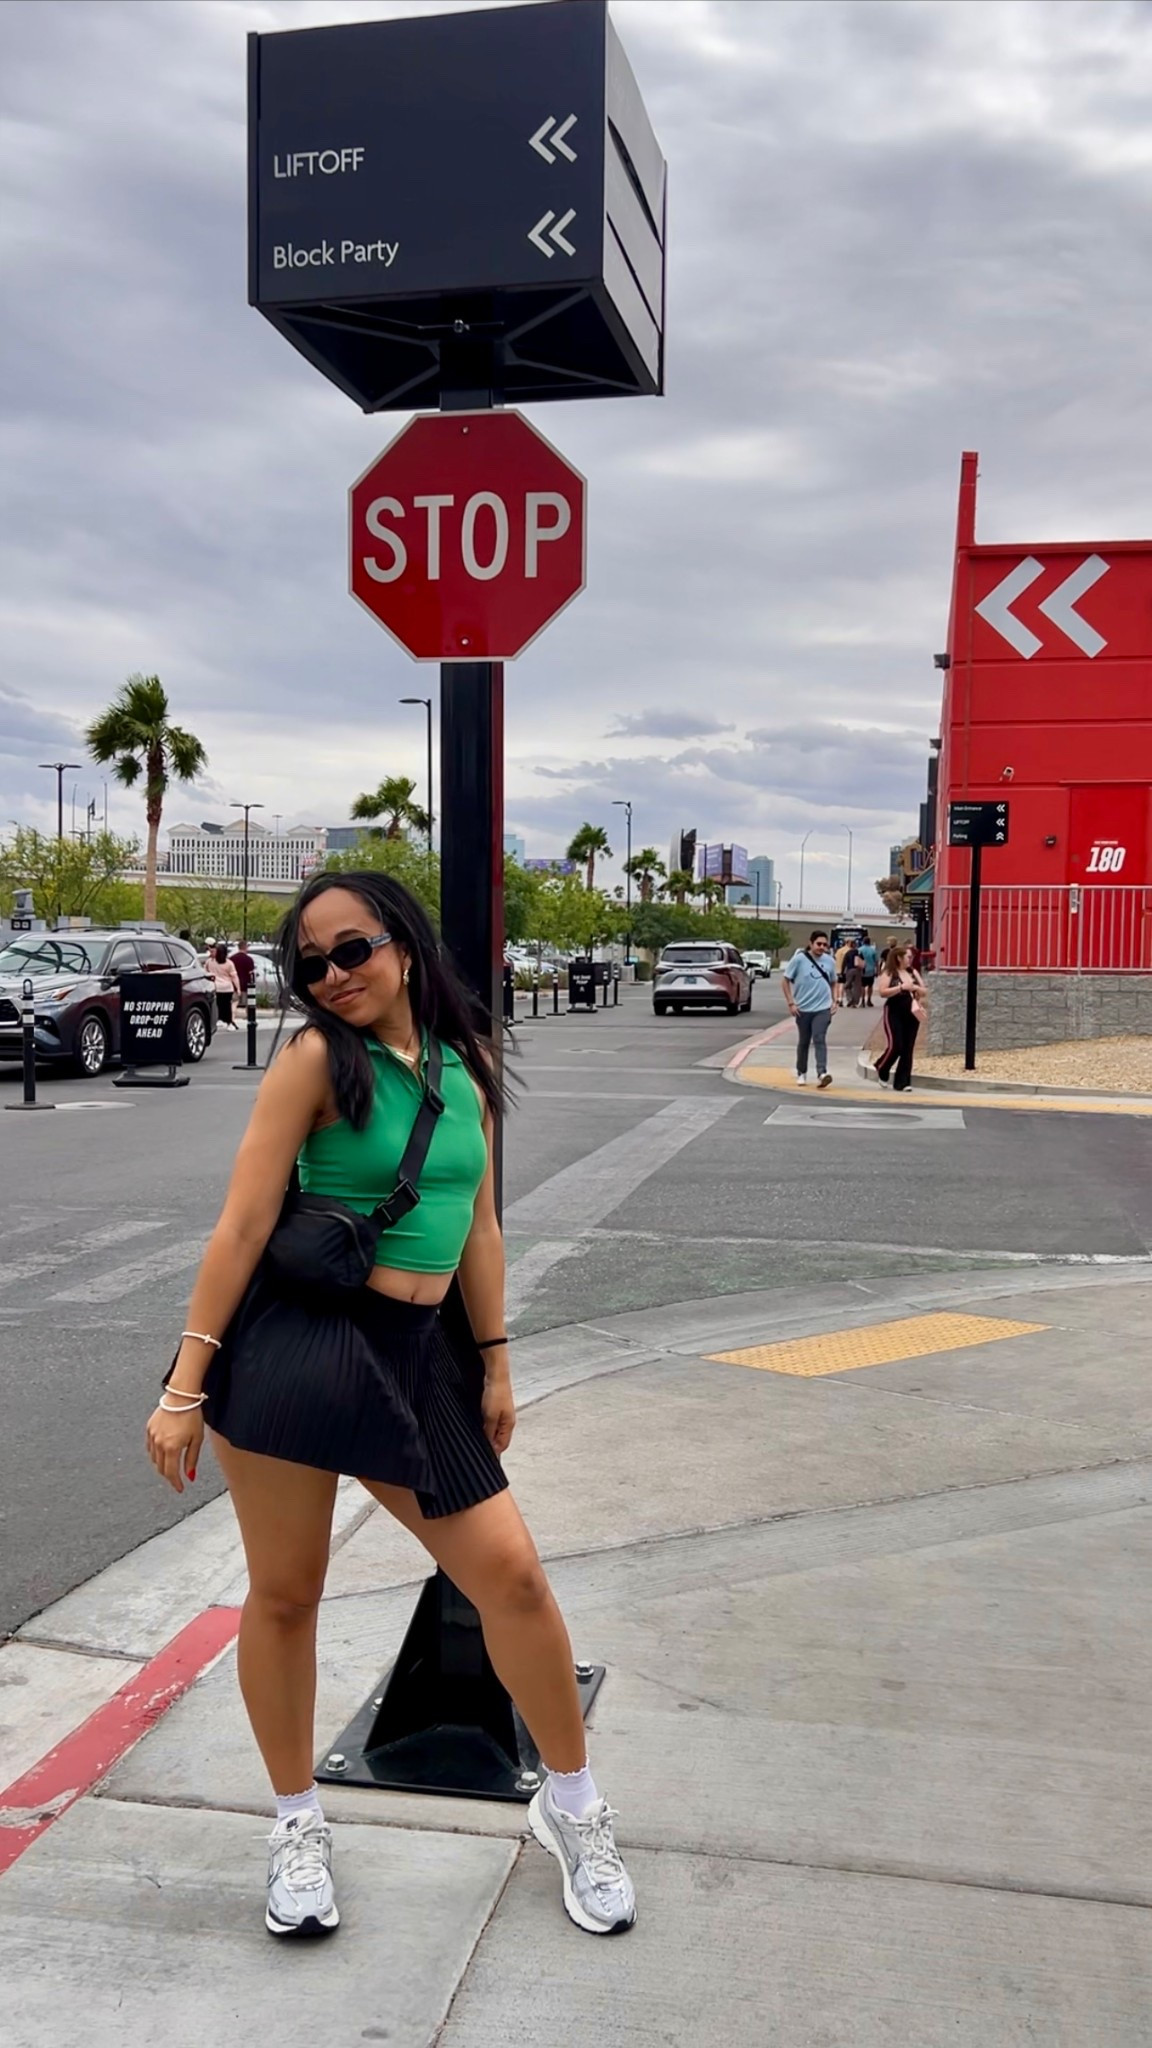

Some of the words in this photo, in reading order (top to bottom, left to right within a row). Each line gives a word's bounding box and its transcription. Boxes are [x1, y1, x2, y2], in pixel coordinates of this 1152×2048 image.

[273, 147, 365, 178] LIFTOFF
[273, 240, 334, 269] Block
[341, 240, 399, 267] Party
[363, 491, 571, 583] STOP
[1085, 846, 1126, 872] 180
[123, 1001, 135, 1012] NO
[136, 1001, 175, 1012] STOPPING
[129, 1014, 169, 1025] DROP-OFF
[136, 1028, 163, 1038] AHEAD
